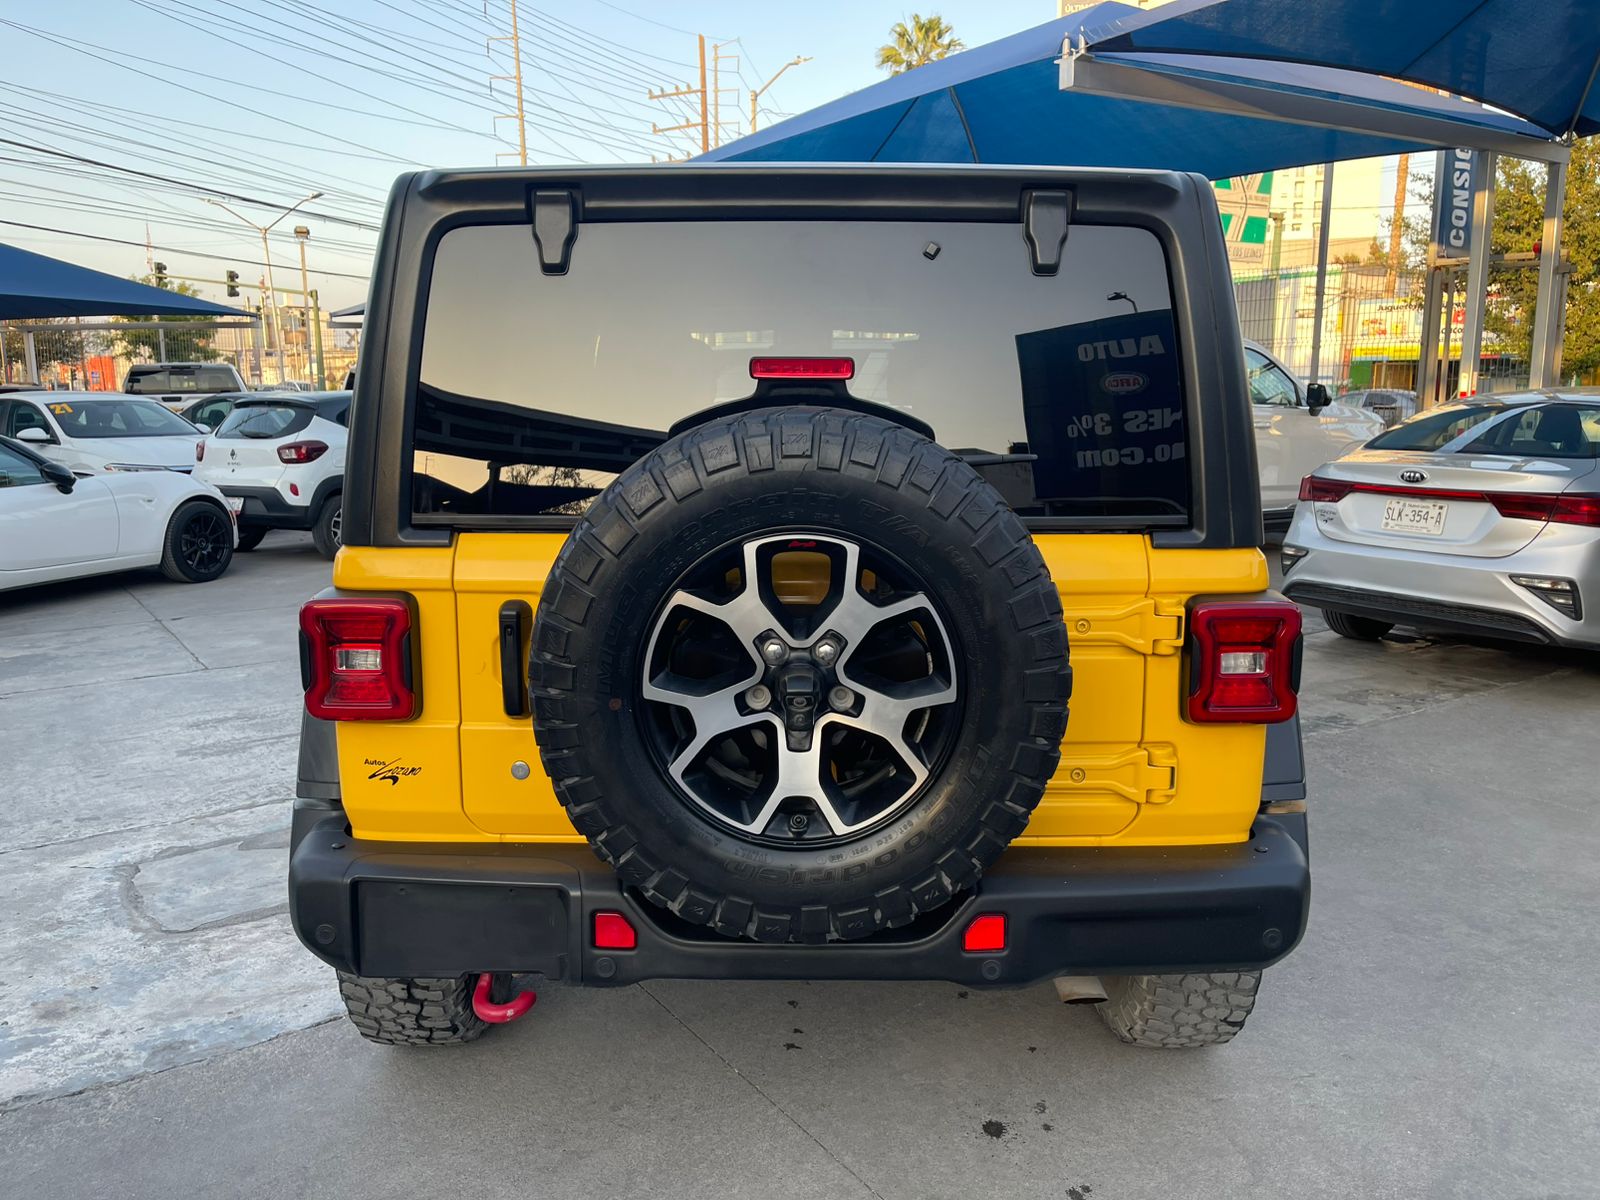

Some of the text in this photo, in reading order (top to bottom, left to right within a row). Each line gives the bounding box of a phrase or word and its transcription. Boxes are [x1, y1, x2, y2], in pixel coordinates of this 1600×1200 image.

[49, 402, 73, 415] 21
[1402, 470, 1423, 482] KIA
[1384, 506, 1442, 528] SLK-354-A
[364, 758, 386, 766] Autos
